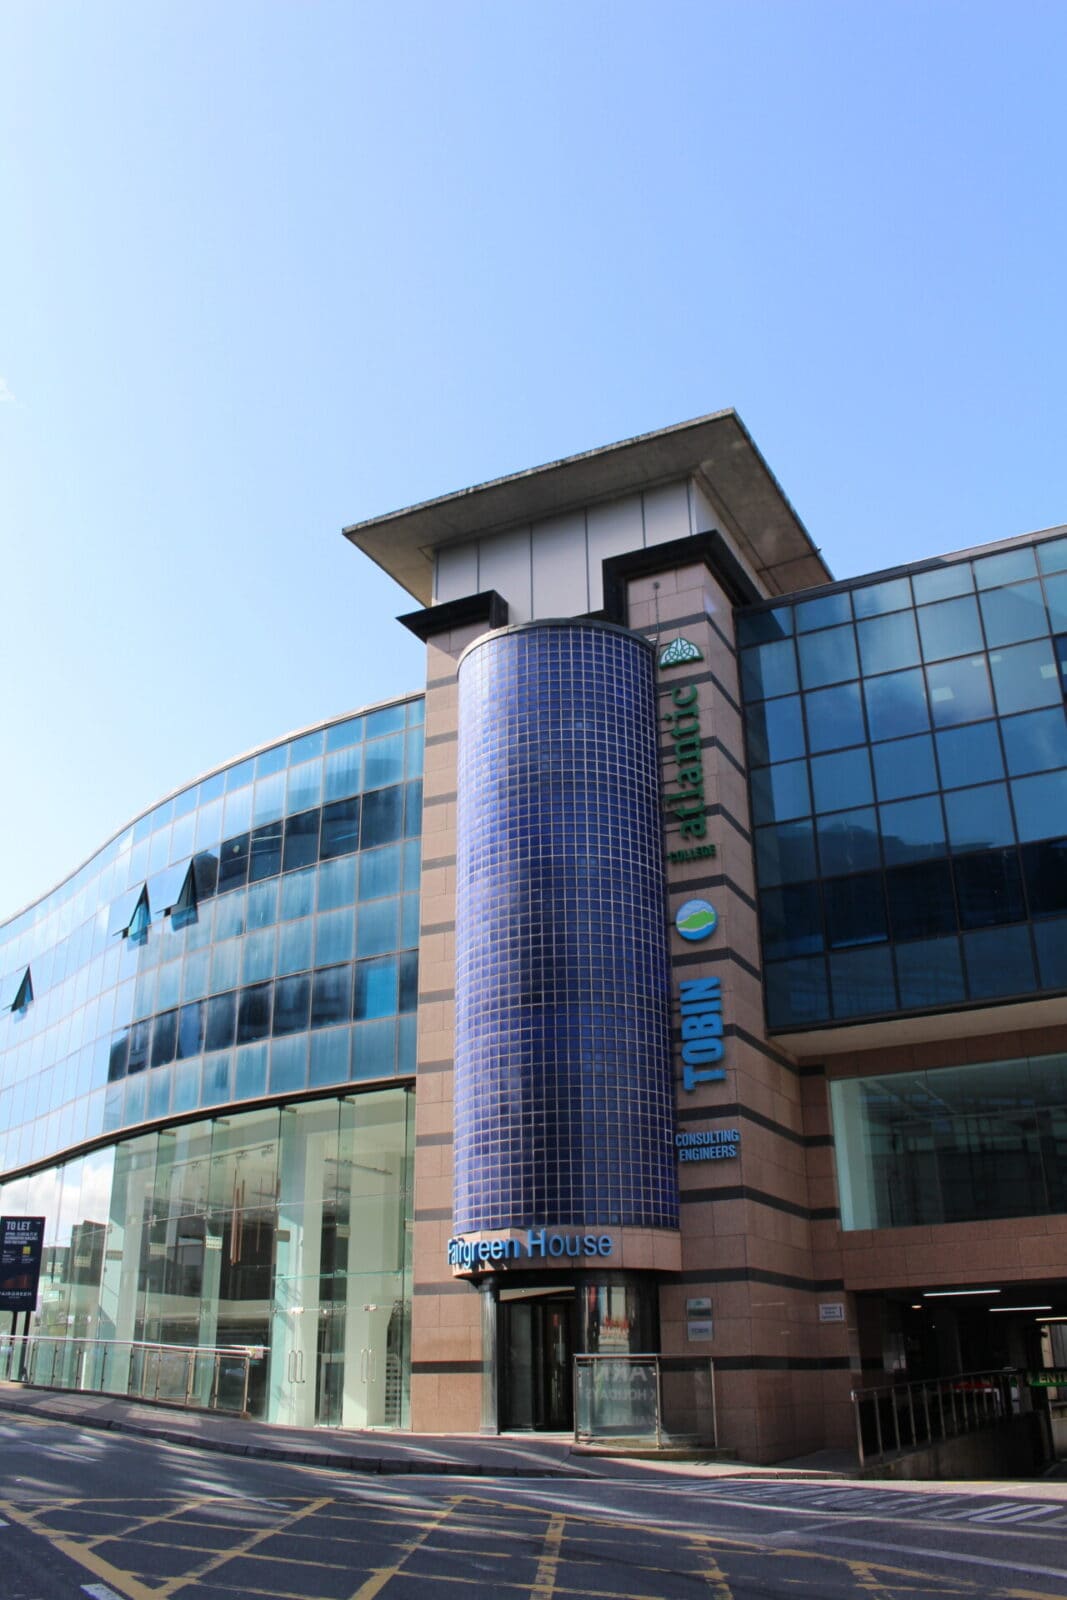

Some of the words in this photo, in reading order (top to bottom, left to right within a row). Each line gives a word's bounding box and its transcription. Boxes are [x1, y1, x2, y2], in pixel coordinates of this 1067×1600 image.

[663, 684, 706, 839] atlantic
[679, 977, 726, 1091] TOBIN
[675, 1128, 740, 1147] CONSULTING
[679, 1145, 737, 1162] ENGINEERS
[6, 1221, 16, 1231] TO
[17, 1221, 31, 1231] LET
[447, 1237, 520, 1268] Fairgreen
[527, 1228, 613, 1257] House
